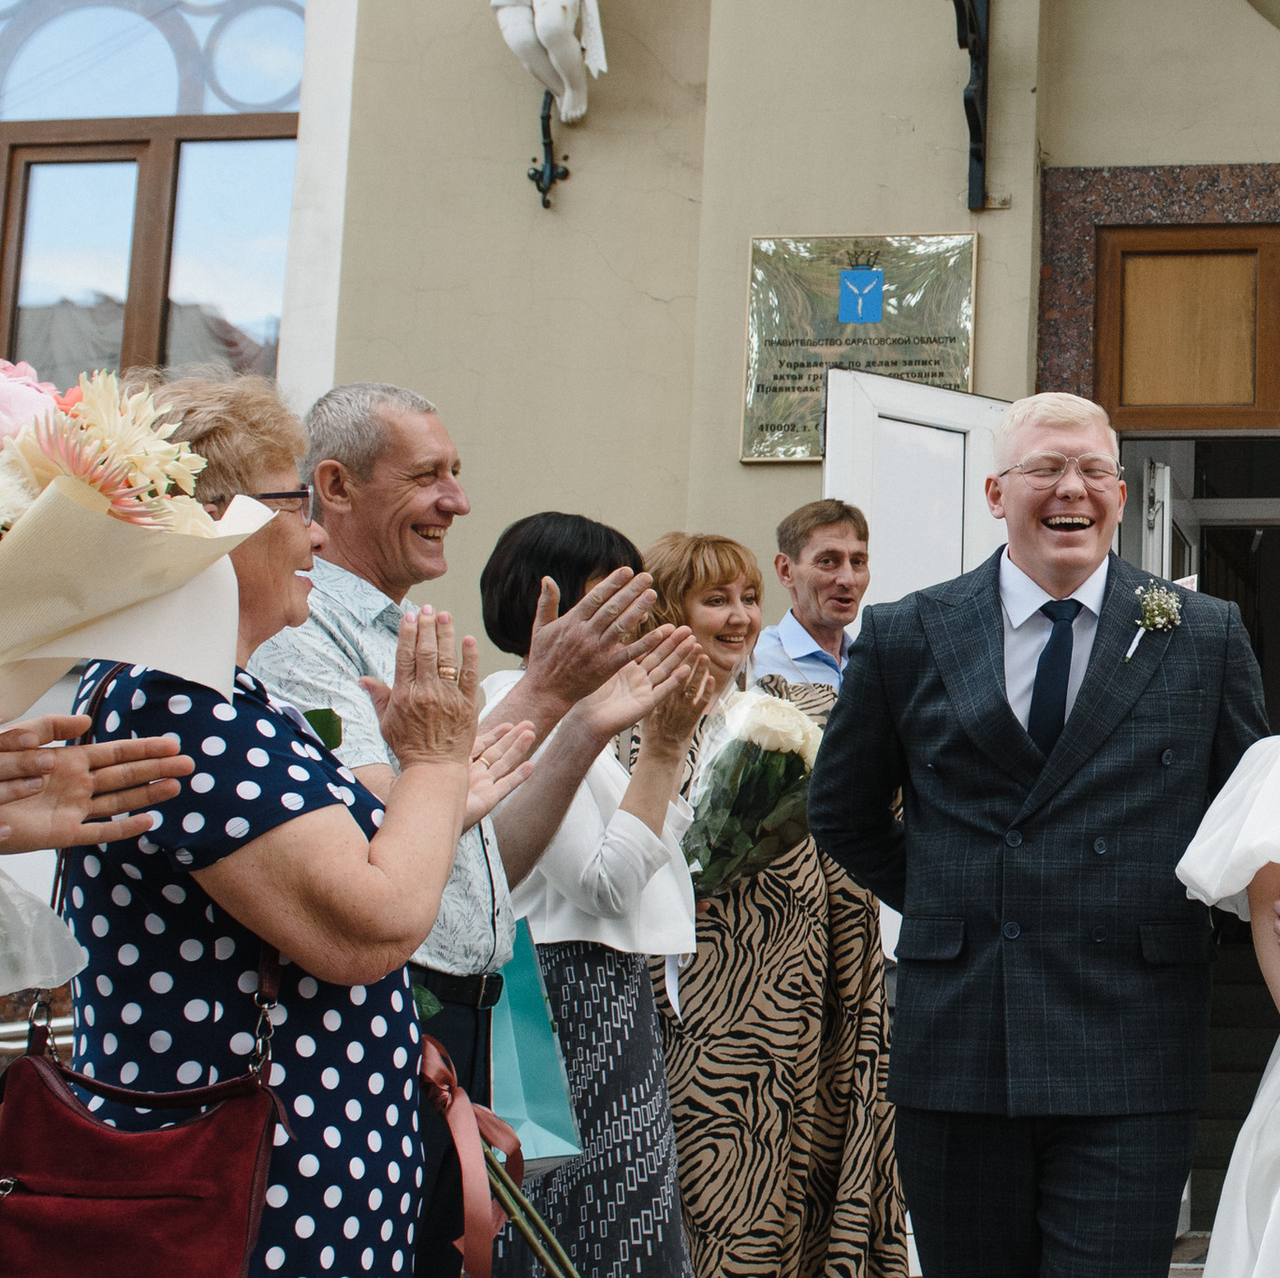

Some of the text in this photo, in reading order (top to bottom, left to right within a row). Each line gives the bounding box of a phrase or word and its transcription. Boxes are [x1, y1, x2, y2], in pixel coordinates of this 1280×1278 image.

[764, 336, 956, 347] ПРАВИТЕЛЬСТВО САРАТОВСКОЙ ОБЛАСТИ
[865, 360, 898, 368] делам
[902, 359, 940, 368] записи
[773, 373, 803, 381] актов
[888, 371, 944, 379] состояния
[756, 384, 821, 393] Правительс
[758, 423, 799, 433] 410002,
